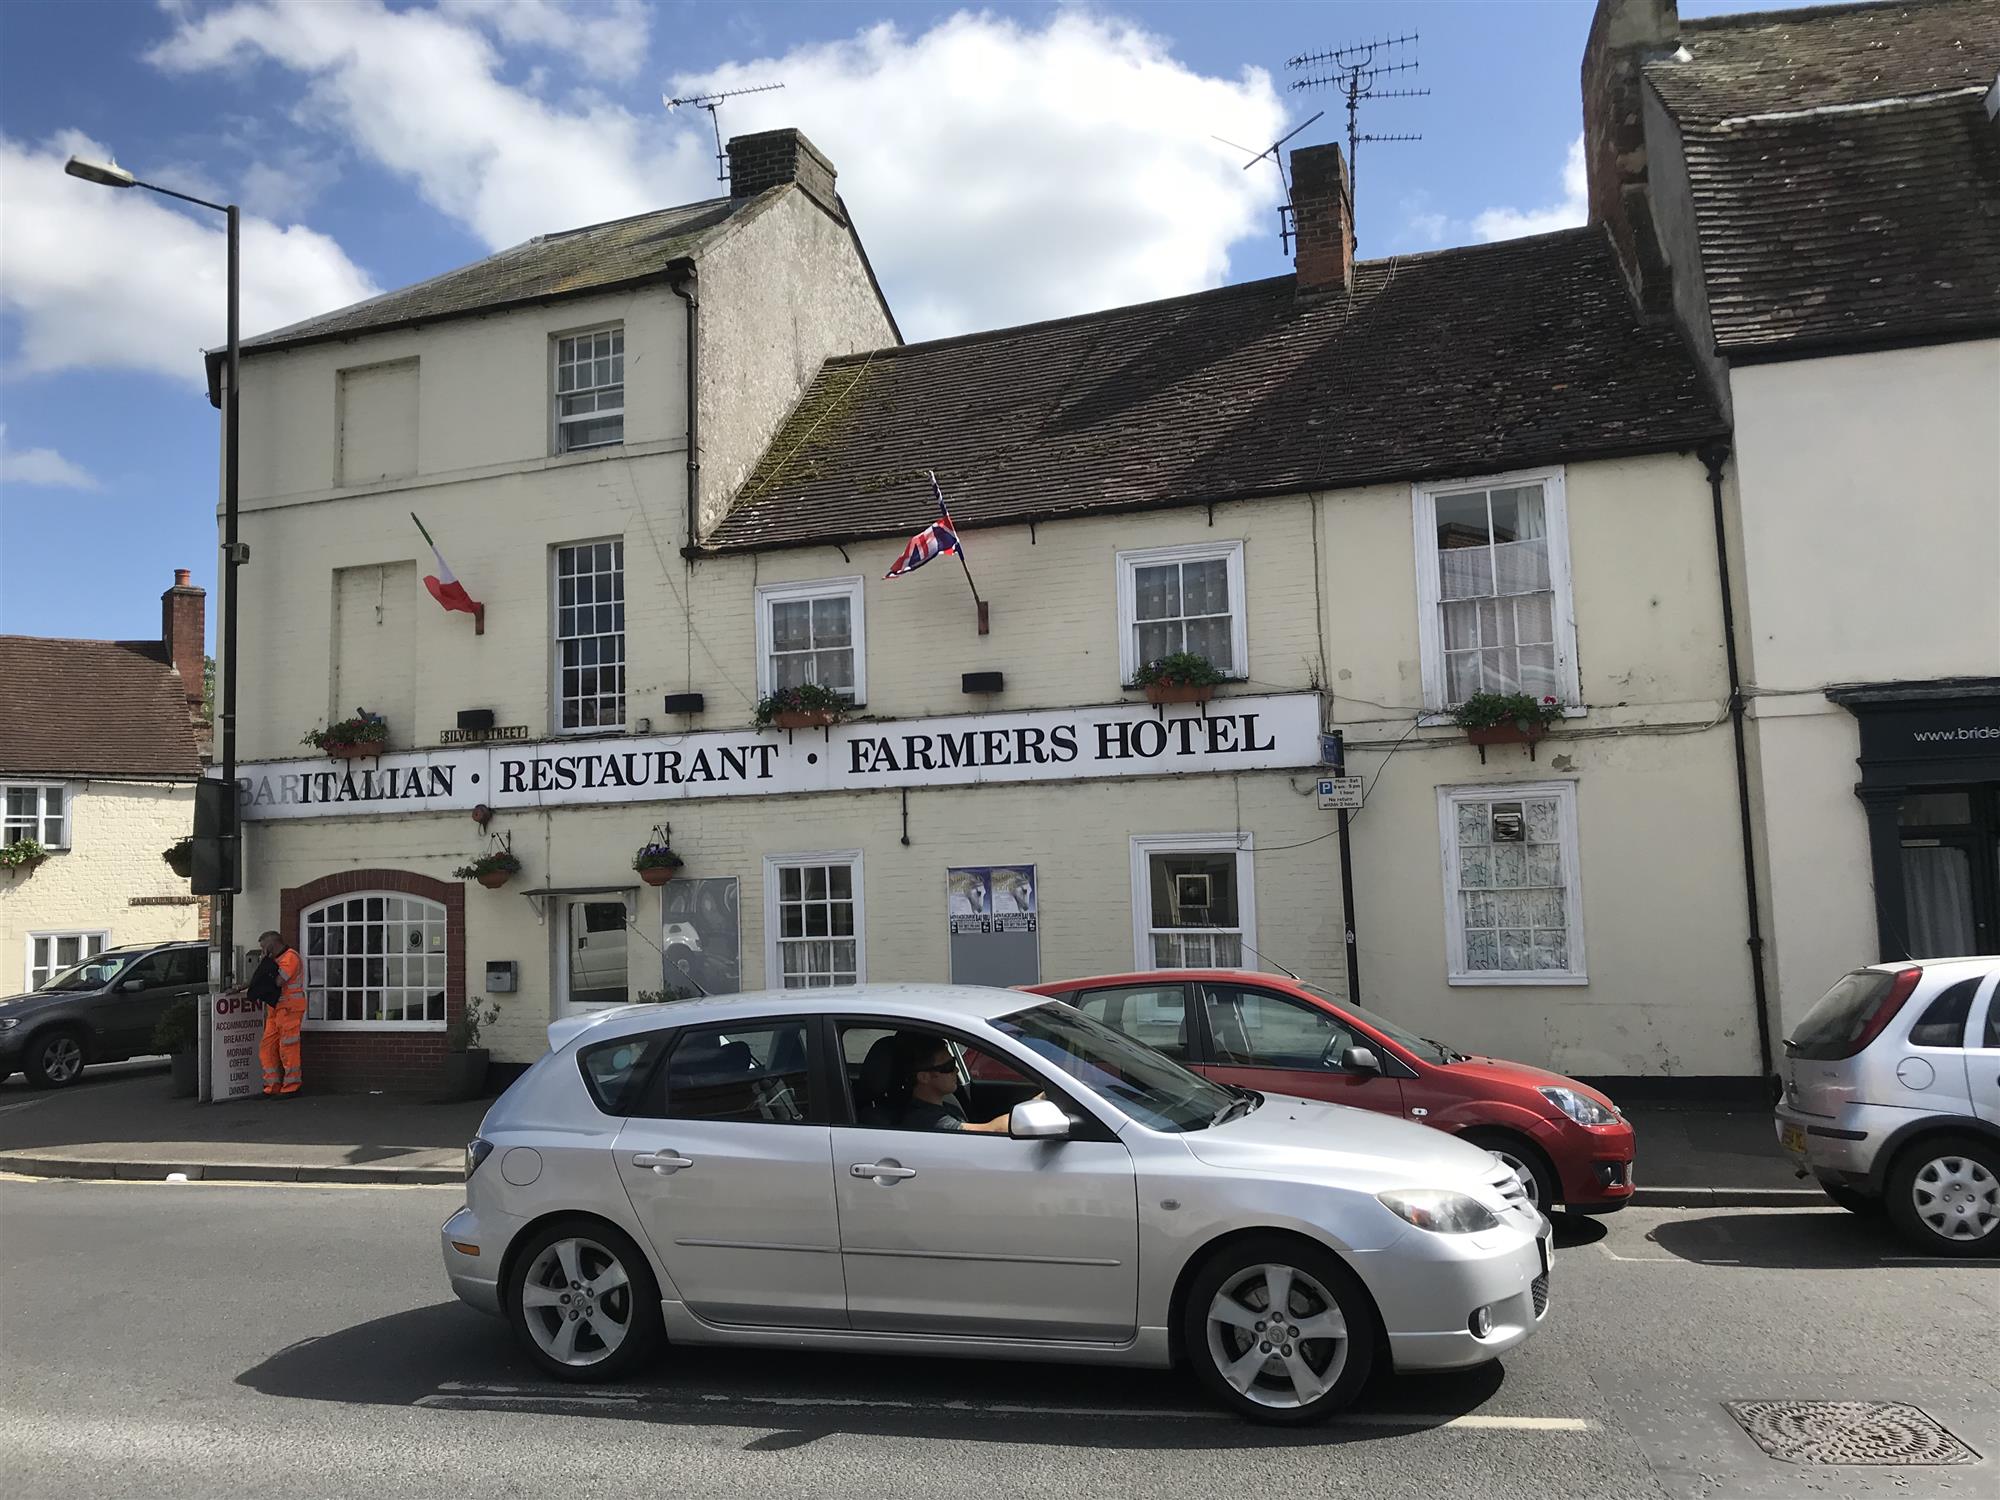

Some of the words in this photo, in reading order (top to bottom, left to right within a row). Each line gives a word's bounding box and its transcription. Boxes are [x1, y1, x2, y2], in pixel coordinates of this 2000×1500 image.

[444, 730, 479, 743] SILVER
[487, 726, 521, 741] STREET
[1913, 726, 2000, 742] www.bride
[299, 765, 456, 804] ITALIAN
[499, 744, 779, 793] RESTAURANT
[847, 725, 1079, 774] FARMERS
[1093, 714, 1275, 760] HOTEL
[1322, 783, 1330, 793] P
[216, 998, 263, 1015] OPEN
[224, 1033, 256, 1044] BREAKFAST
[227, 1047, 253, 1057] MORNING
[229, 1058, 250, 1068] COFFEE
[230, 1071, 249, 1081] LUNCH
[228, 1085, 250, 1096] DINNER
